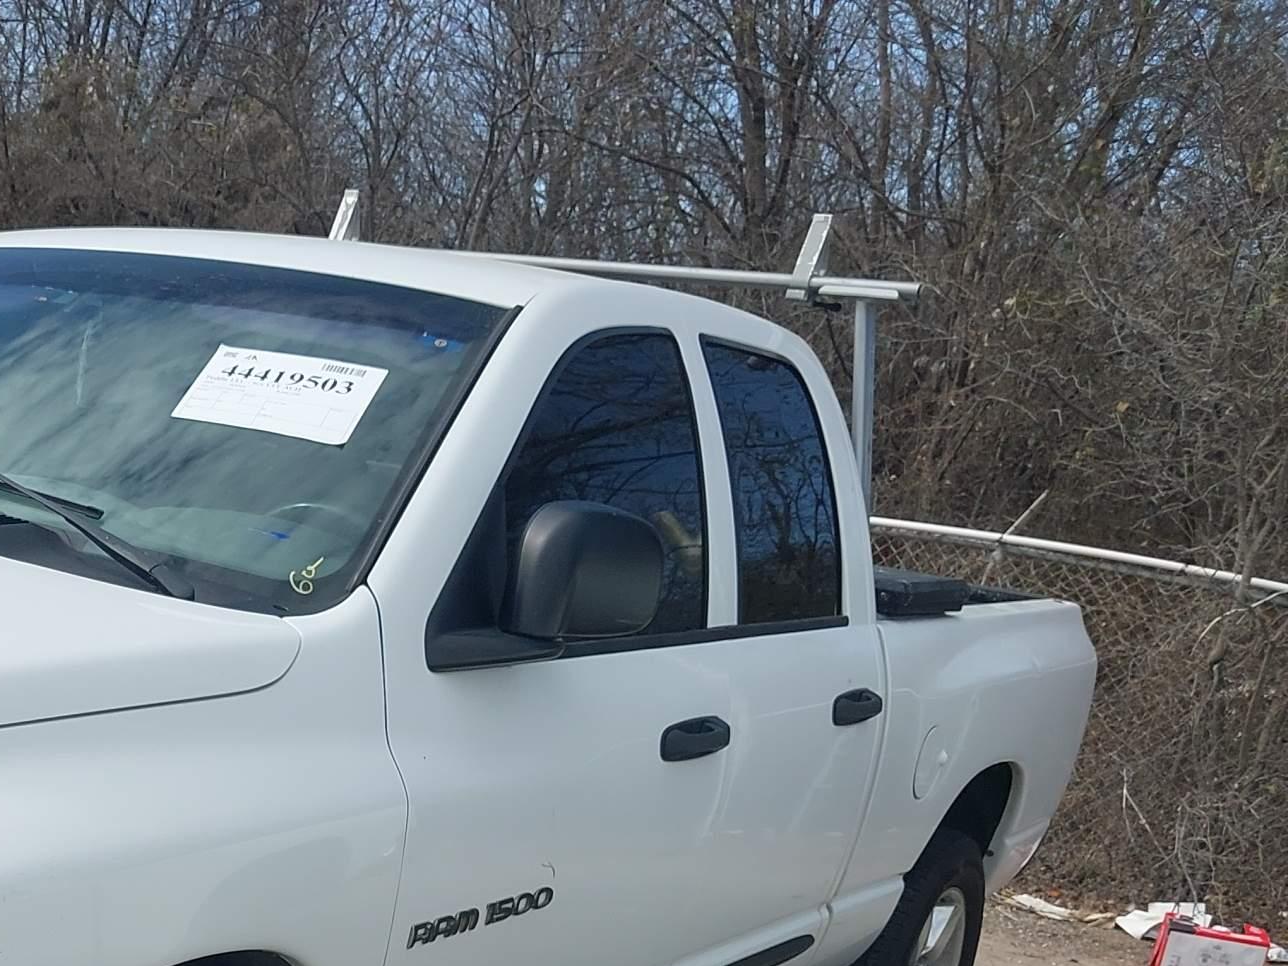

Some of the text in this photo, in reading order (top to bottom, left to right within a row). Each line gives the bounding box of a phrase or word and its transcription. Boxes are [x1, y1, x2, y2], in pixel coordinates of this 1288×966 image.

[221, 364, 355, 395] 44419503
[406, 886, 554, 950] RAM 1500
